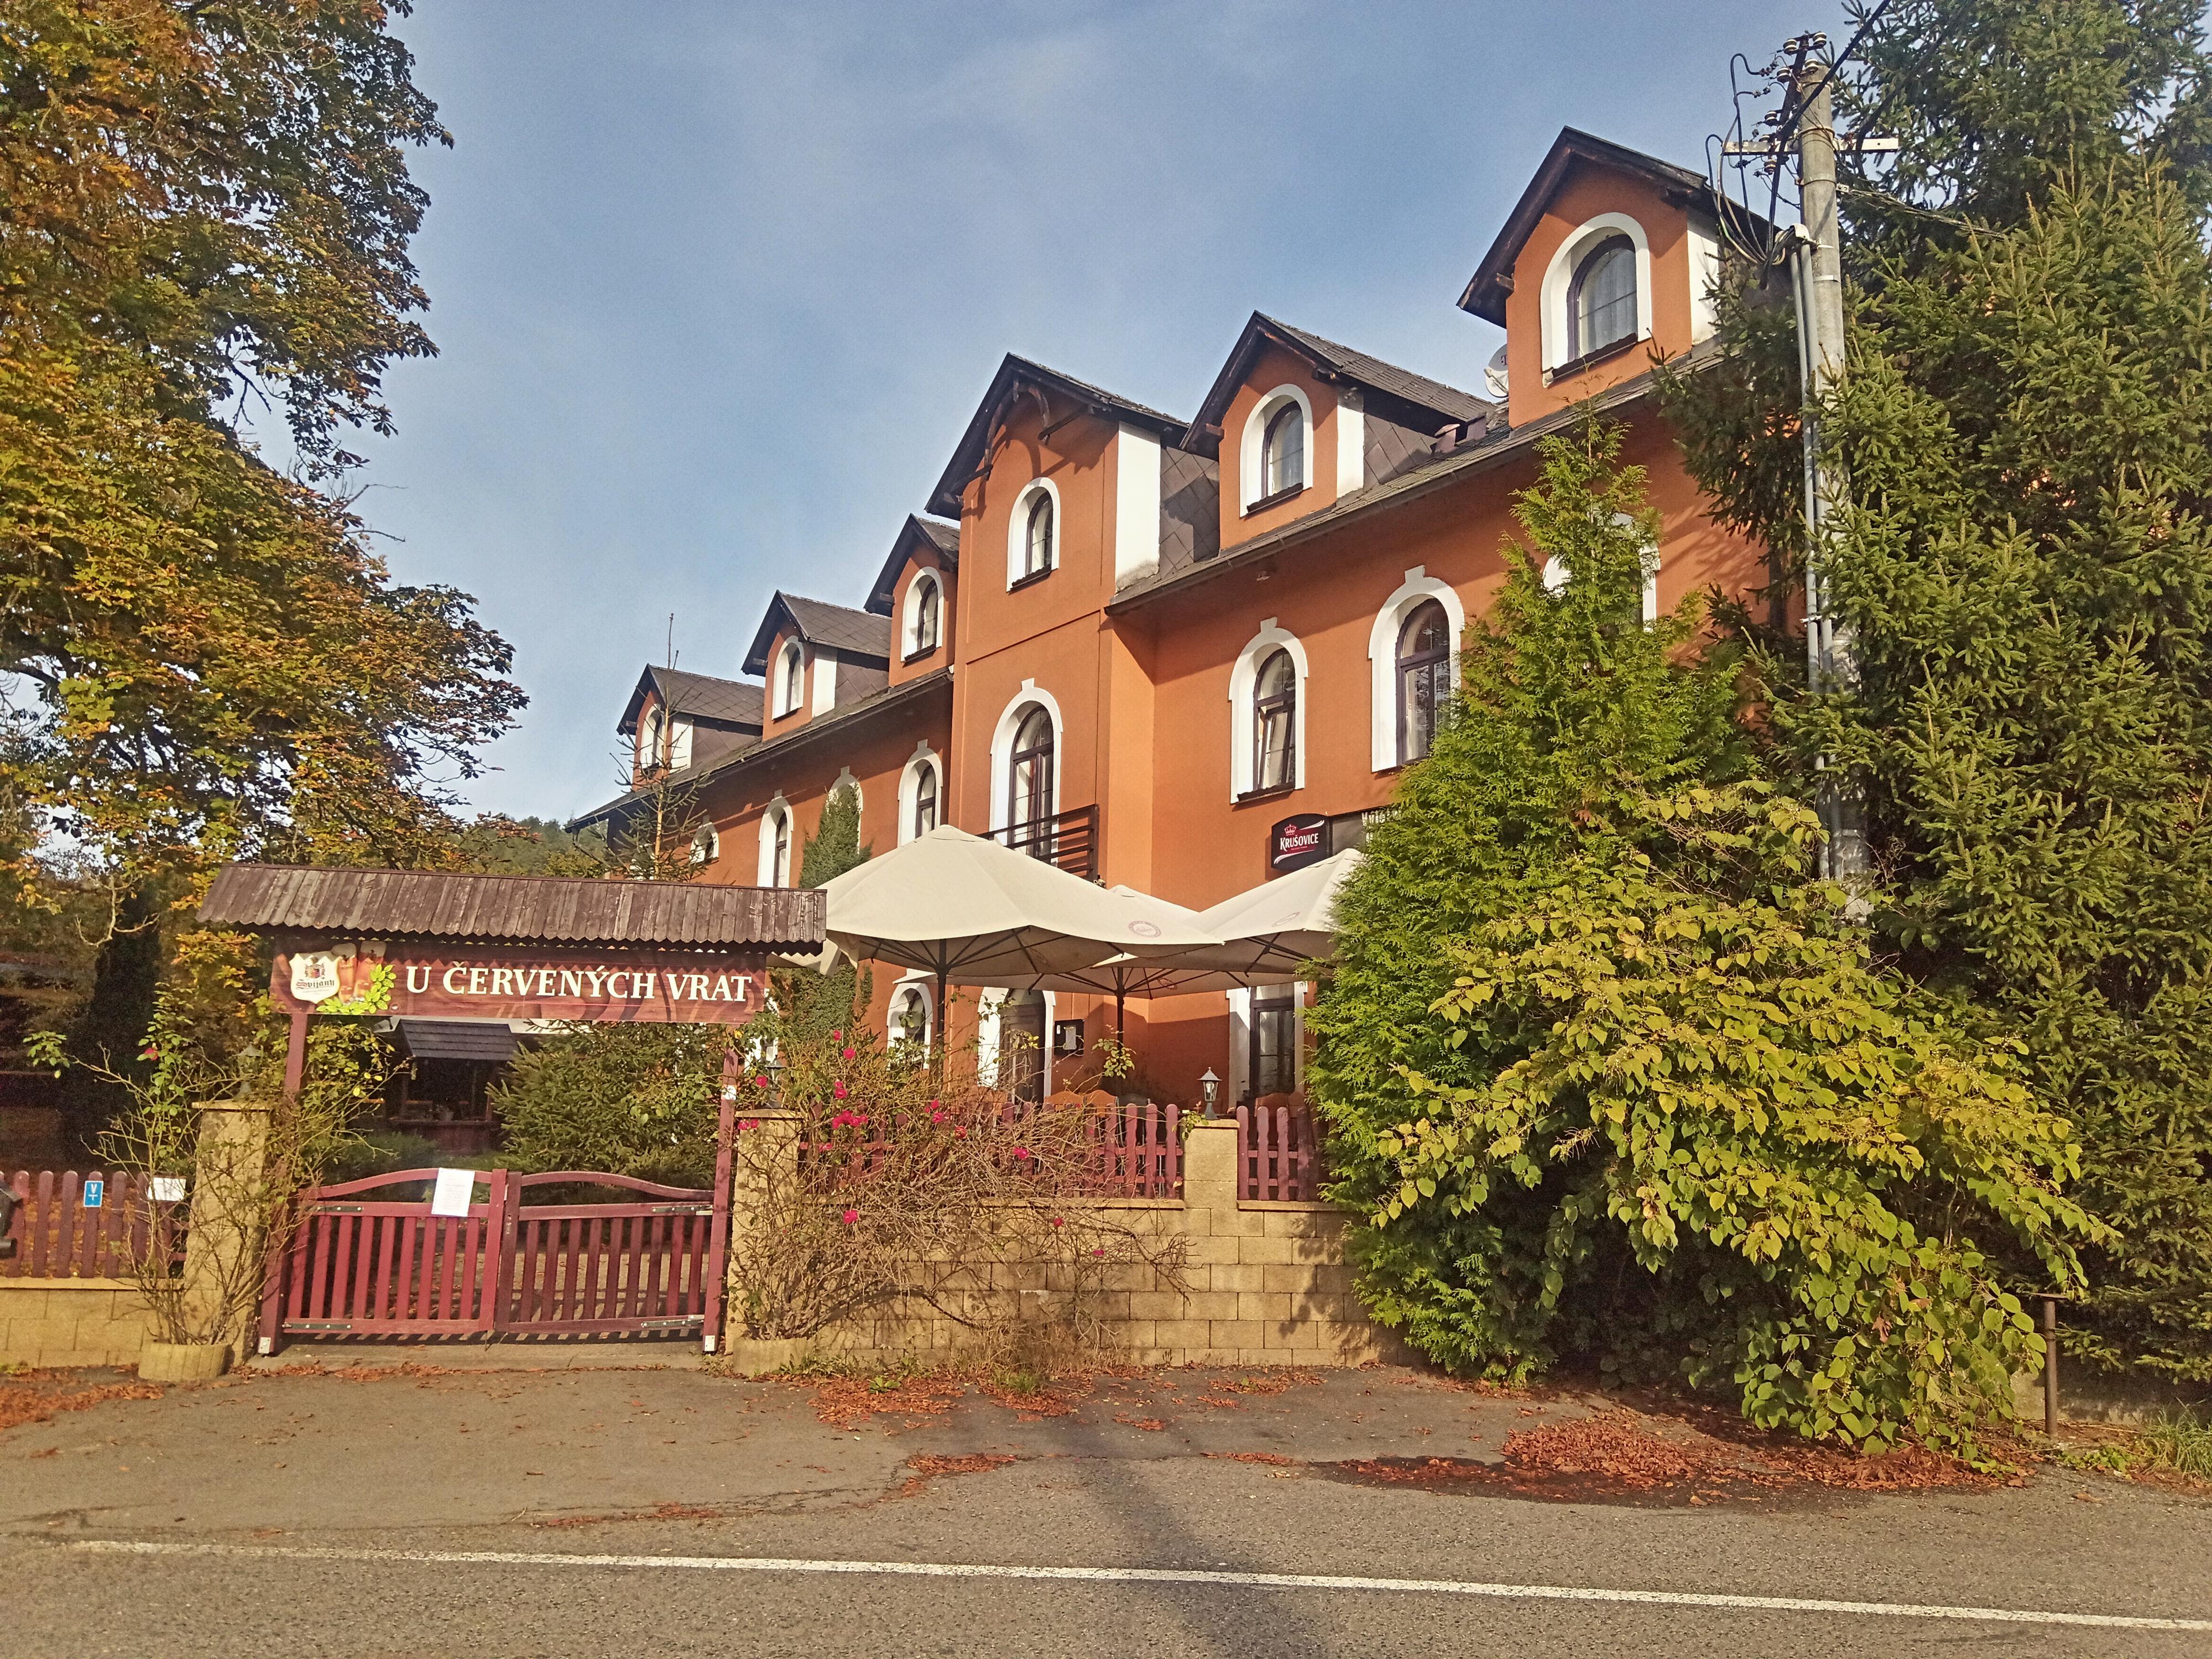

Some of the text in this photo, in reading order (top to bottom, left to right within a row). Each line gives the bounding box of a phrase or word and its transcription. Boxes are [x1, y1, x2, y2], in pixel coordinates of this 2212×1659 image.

[1280, 833, 1319, 852] KRUŠOVICE
[296, 979, 335, 990] Svijany
[406, 961, 752, 1001] U ČERVENÝCH VRAT
